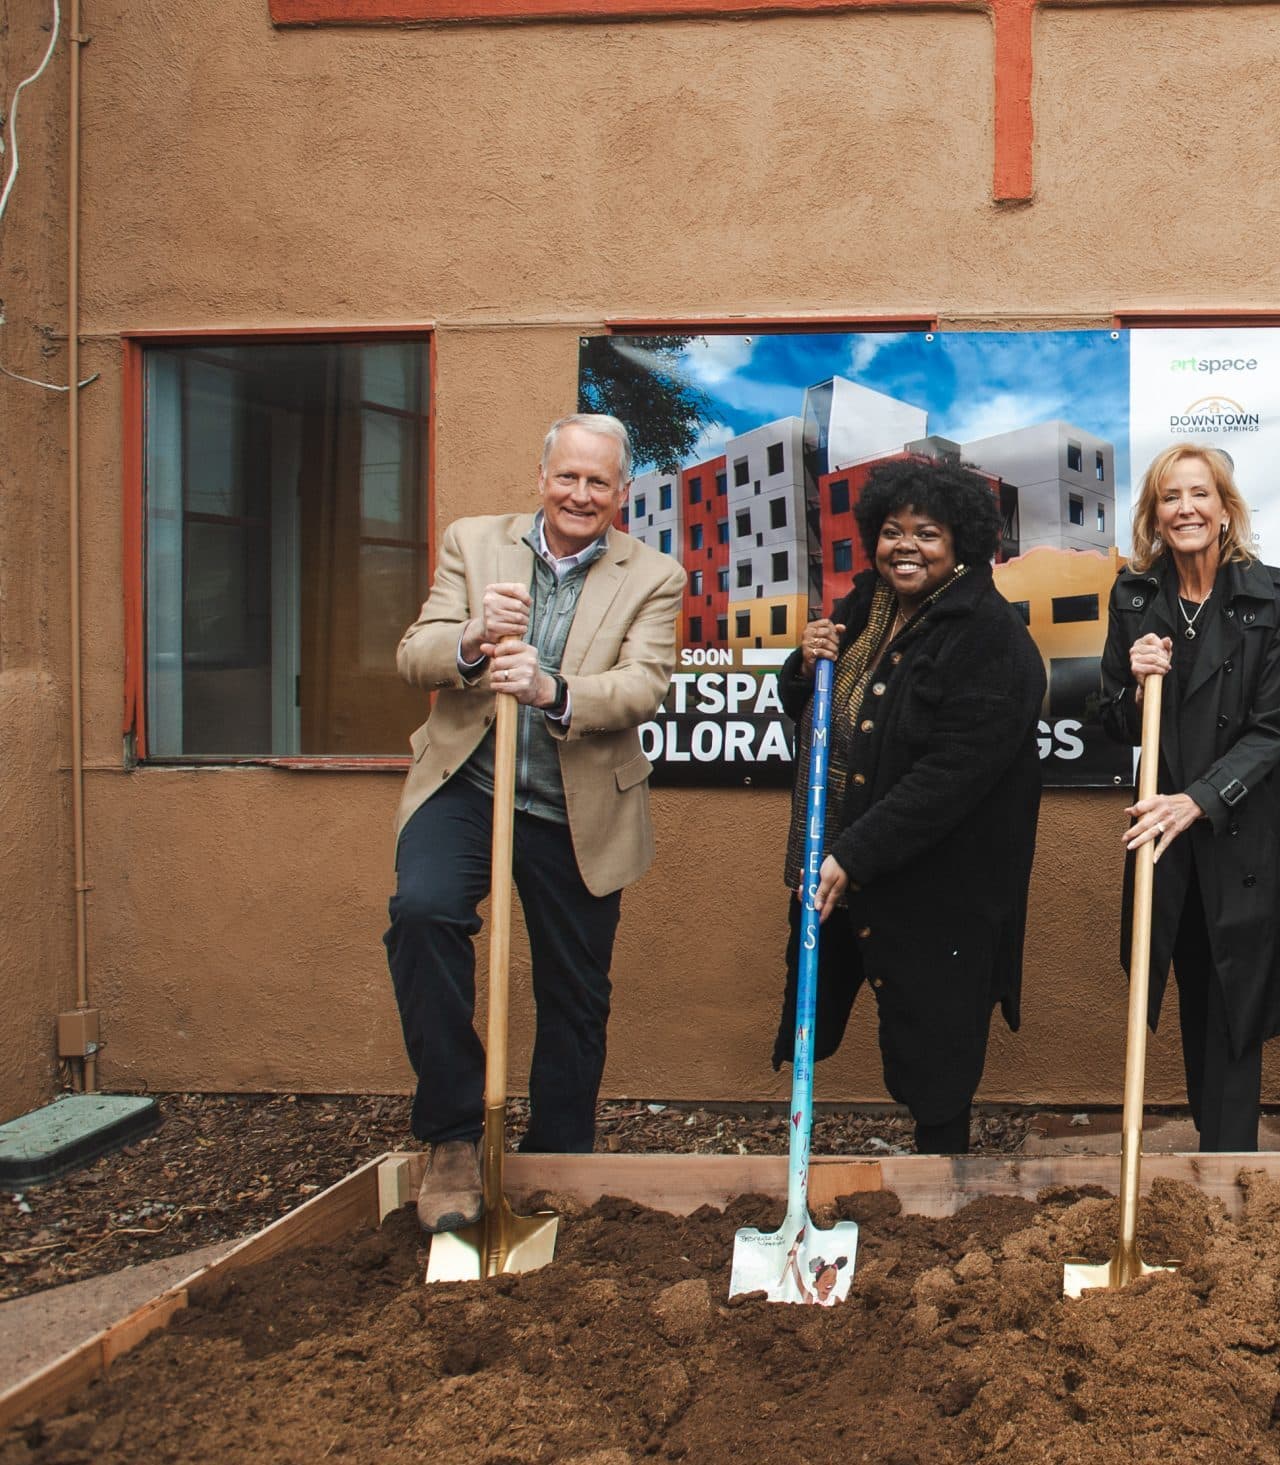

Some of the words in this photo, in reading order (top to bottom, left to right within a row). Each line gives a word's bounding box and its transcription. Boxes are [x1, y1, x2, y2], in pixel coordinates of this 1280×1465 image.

[1169, 357, 1258, 375] artspace
[1169, 414, 1260, 426] DOWNTOWN
[680, 648, 733, 666] SOON
[656, 673, 784, 714] TSPA
[637, 720, 796, 762] OLORA
